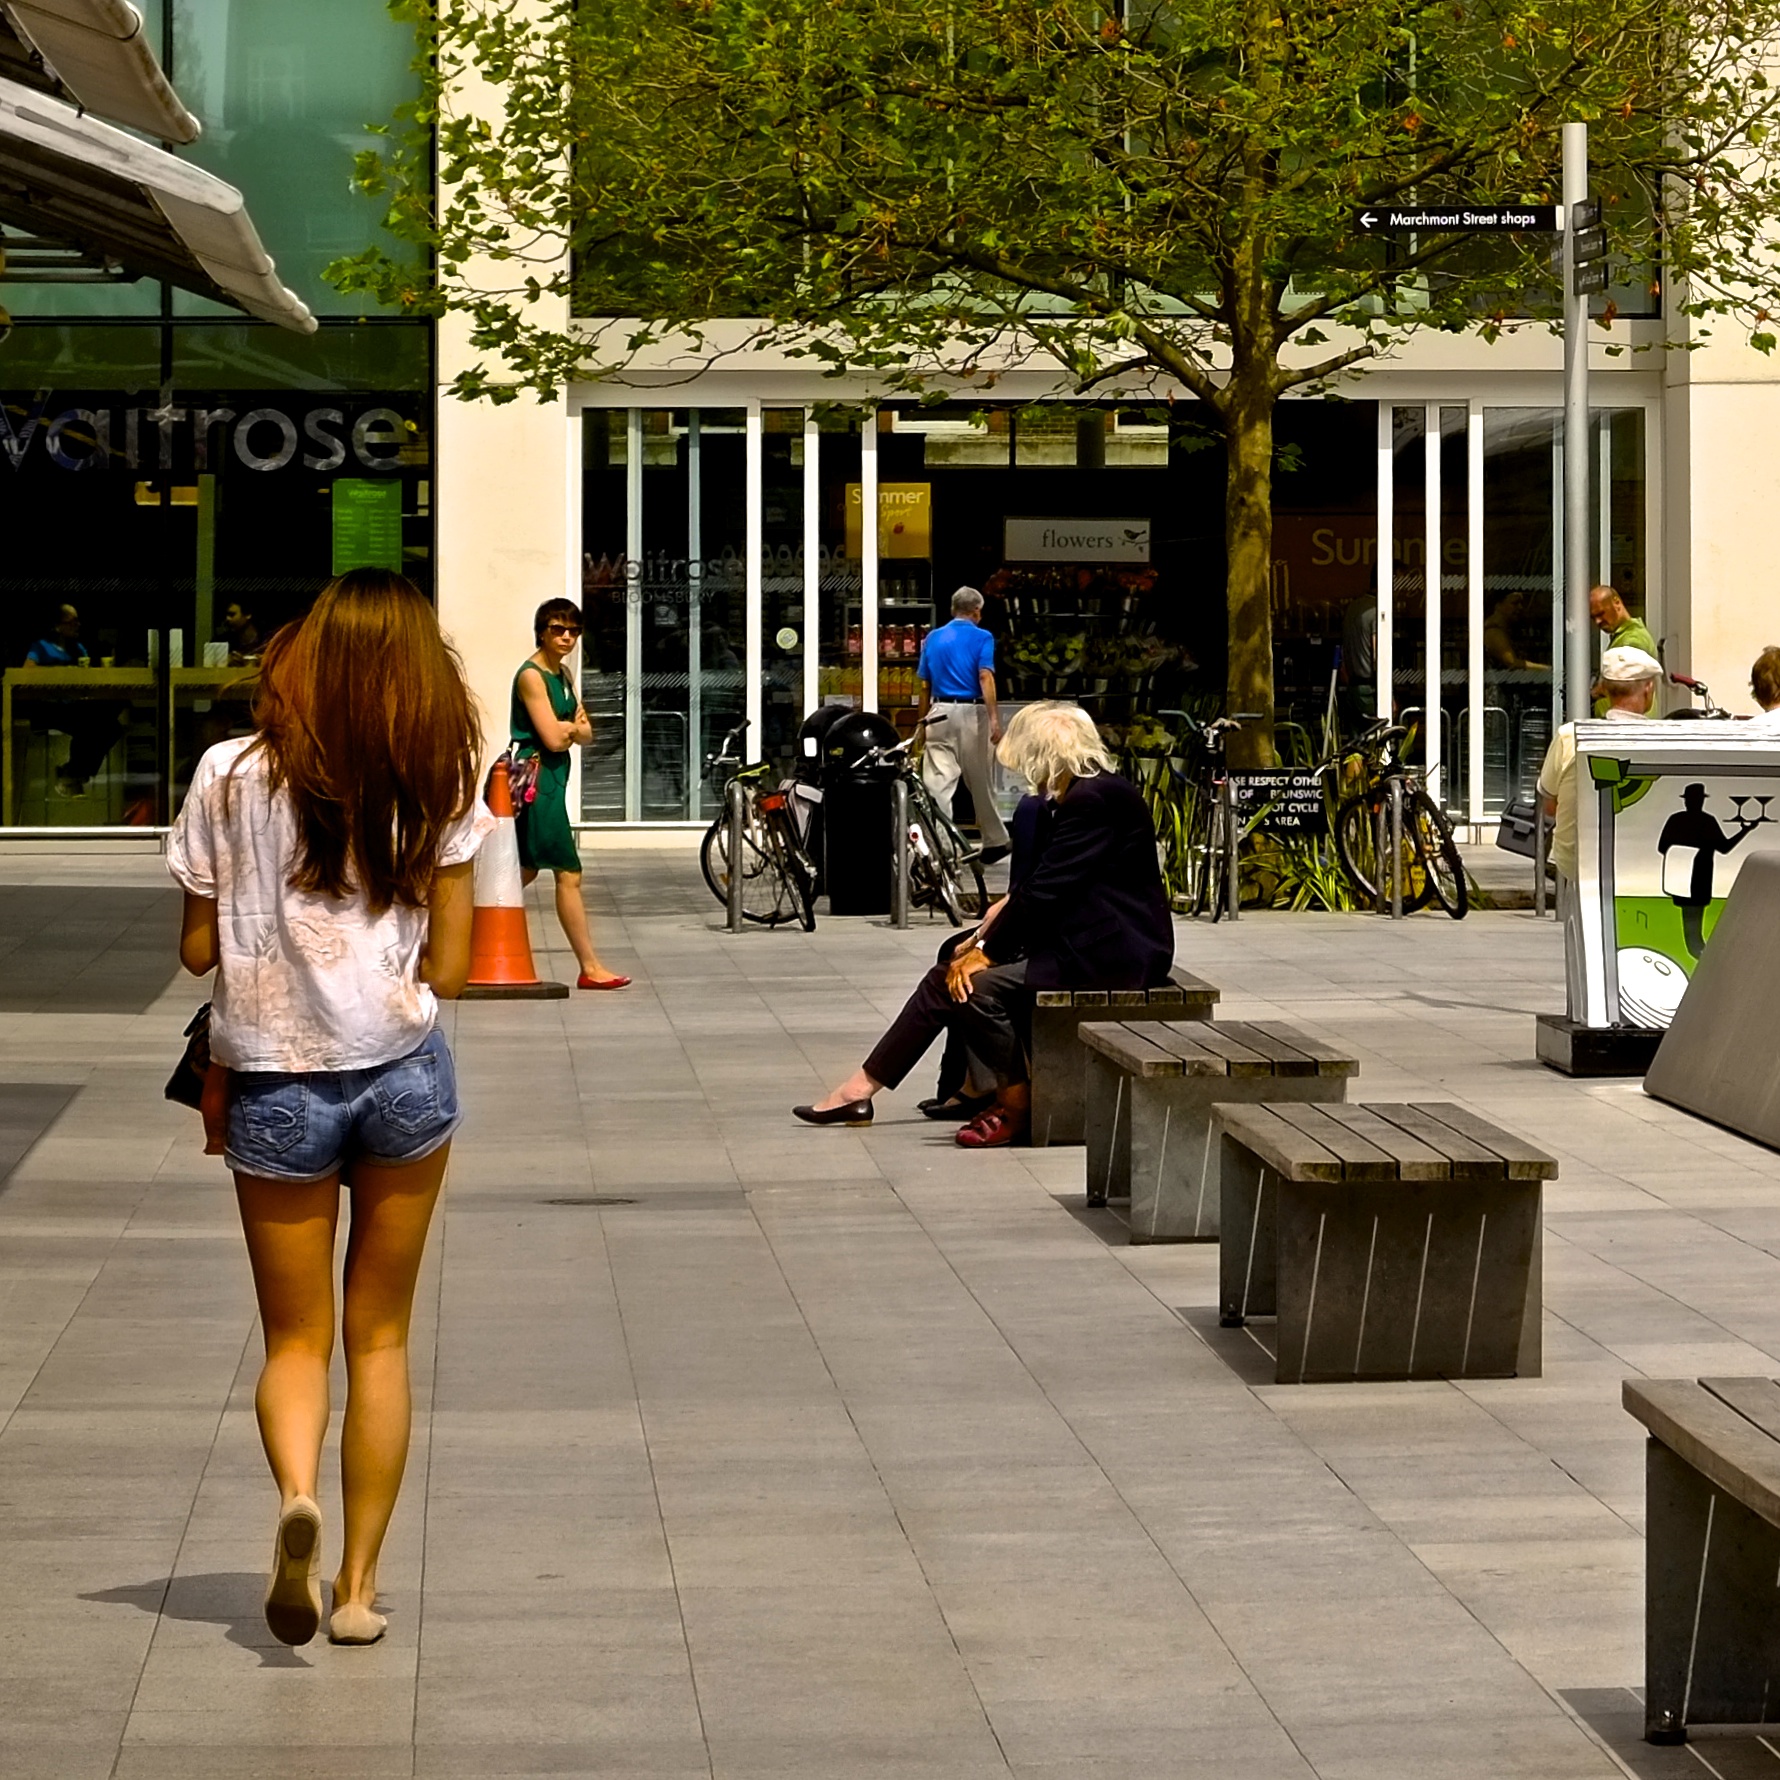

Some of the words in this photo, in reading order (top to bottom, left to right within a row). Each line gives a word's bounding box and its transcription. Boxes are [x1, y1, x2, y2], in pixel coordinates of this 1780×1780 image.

[1389, 211, 1459, 227] Marchmont
[1462, 211, 1498, 225] Street
[1500, 210, 1536, 228] shops
[852, 488, 924, 504] Smmer
[1041, 529, 1114, 548] flowers
[611, 592, 716, 604] BLOOMSBURY
[1248, 776, 1290, 787] RESPECT
[1239, 789, 1254, 800] OF
[1270, 789, 1323, 800] BRUNSWIC
[1288, 803, 1319, 813] CYCLE
